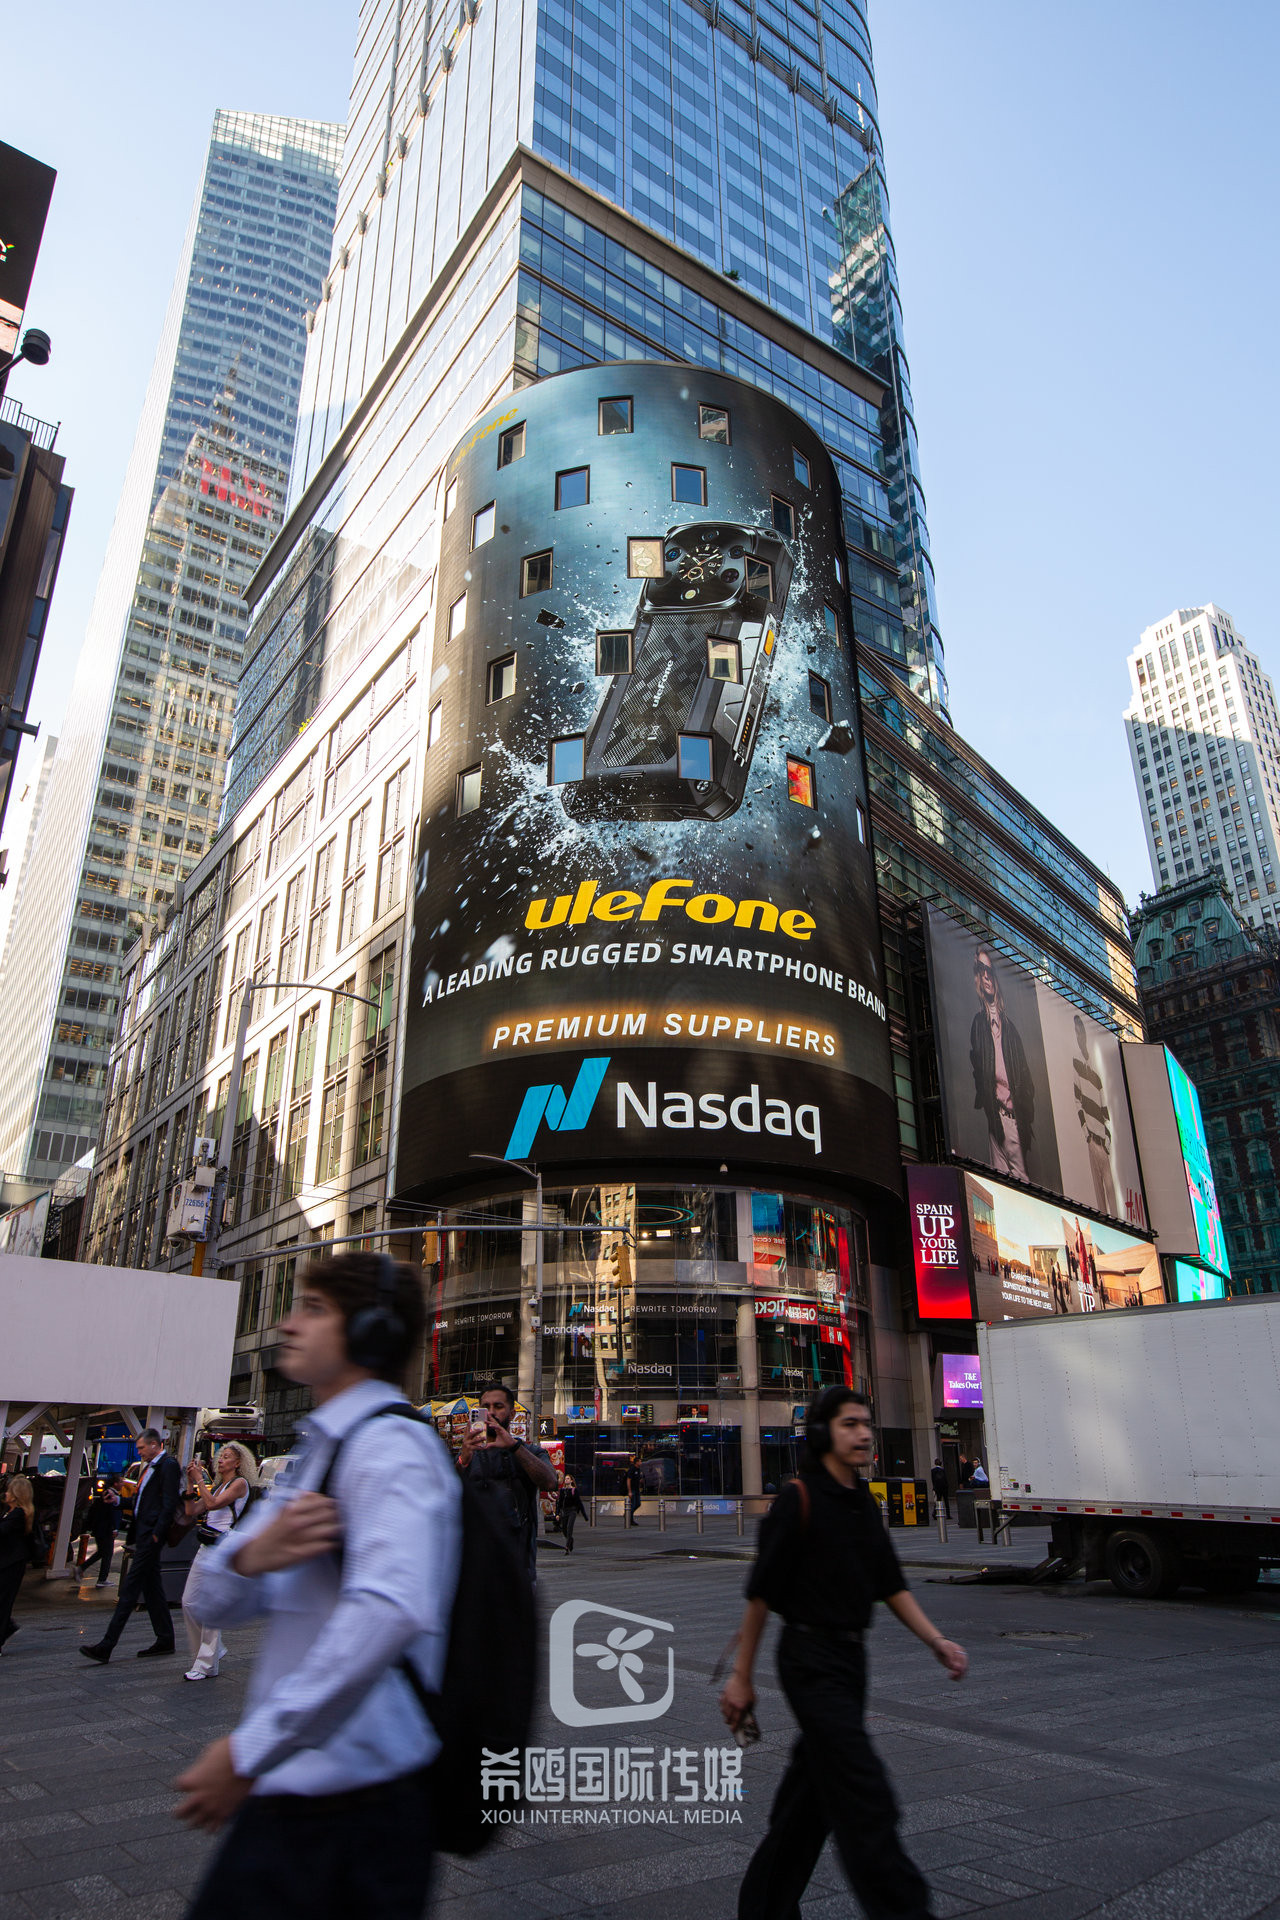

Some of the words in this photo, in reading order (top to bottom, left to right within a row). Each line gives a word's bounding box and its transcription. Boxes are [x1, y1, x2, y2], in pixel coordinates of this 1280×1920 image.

[422, 986, 434, 1008] A
[436, 952, 533, 1000] LEADING
[540, 942, 662, 971] RUGGED
[670, 943, 844, 993] SMARTPHONE
[848, 978, 887, 1022] BRAND
[492, 1013, 647, 1050] PREMIUM
[663, 1013, 836, 1057] SUPPLIERS
[616, 1081, 822, 1155] Nasdaq
[916, 1203, 953, 1216] SPAIN
[1125, 1187, 1145, 1228] H&M
[917, 1215, 955, 1238] UP
[919, 1238, 957, 1250] YOUR
[920, 1250, 959, 1265] LIFE
[584, 1304, 615, 1314] Nasdaq
[630, 1305, 667, 1313] REWRITE
[671, 1305, 718, 1314] TOMORROW
[1079, 1292, 1096, 1313] UP
[477, 1311, 513, 1323] TOMORROW
[544, 1324, 586, 1335] branded
[627, 1362, 673, 1377] Nasdaq
[948, 1381, 966, 1389] Takes
[965, 1381, 980, 1390] Over
